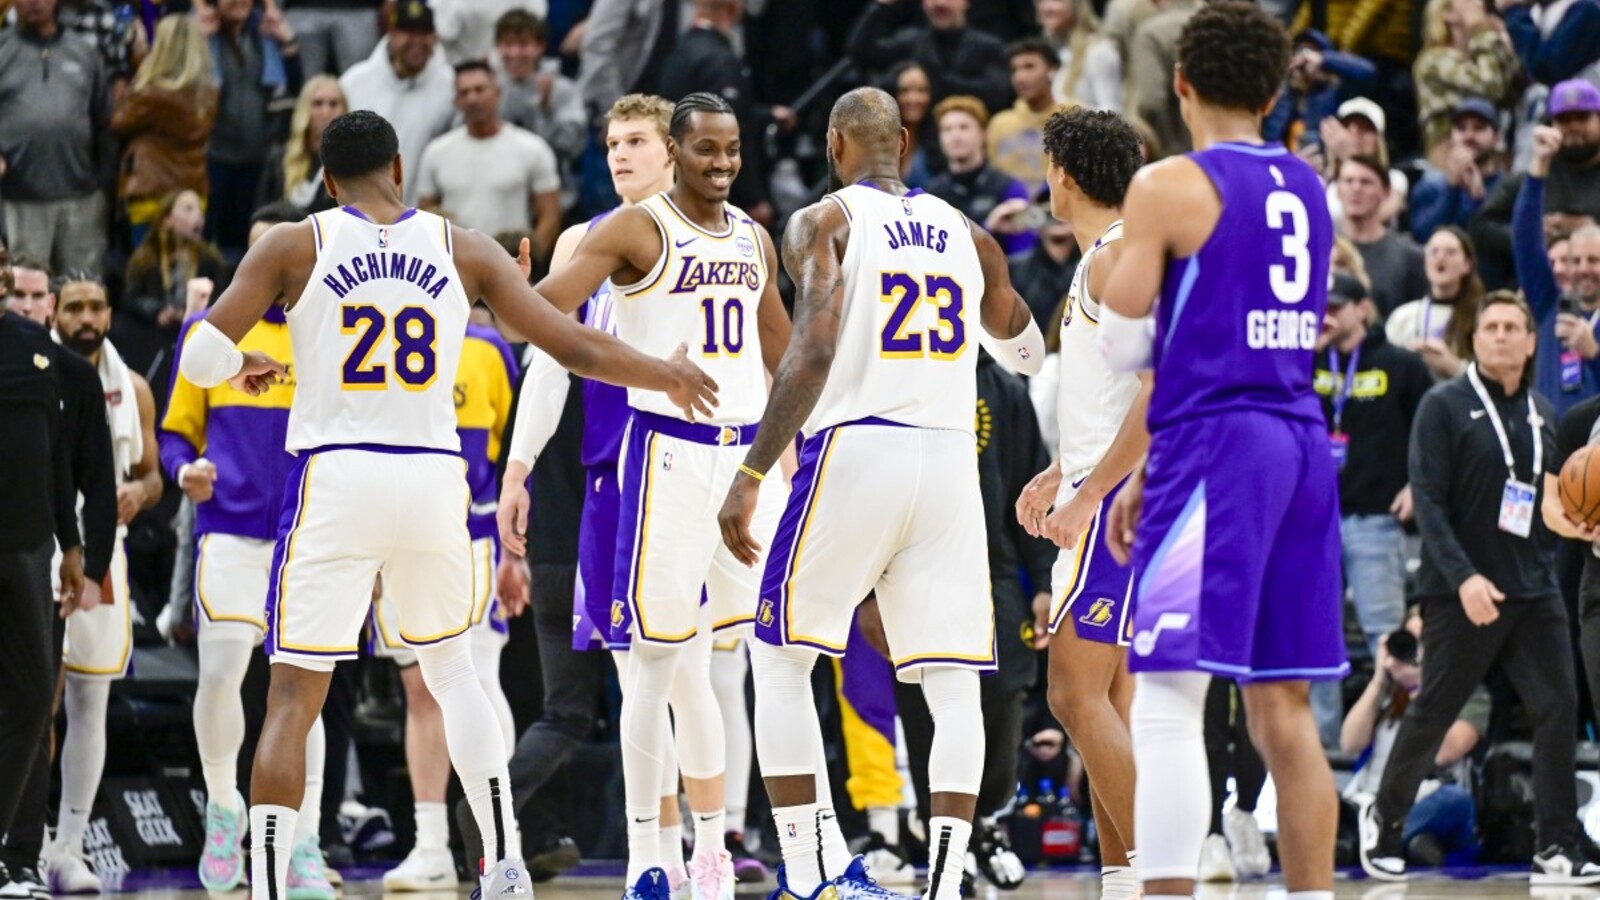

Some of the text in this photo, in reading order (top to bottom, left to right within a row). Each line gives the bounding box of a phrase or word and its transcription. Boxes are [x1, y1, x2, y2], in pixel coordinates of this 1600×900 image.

[883, 220, 949, 254] JAMES
[1265, 190, 1311, 304] 3
[322, 252, 449, 300] HACHIMURA
[668, 255, 760, 294] LAKERS
[700, 297, 744, 358] 10
[880, 270, 967, 361] 23
[340, 303, 438, 392] 28
[123, 788, 164, 819] SEAT
[136, 816, 182, 846] GEEK
